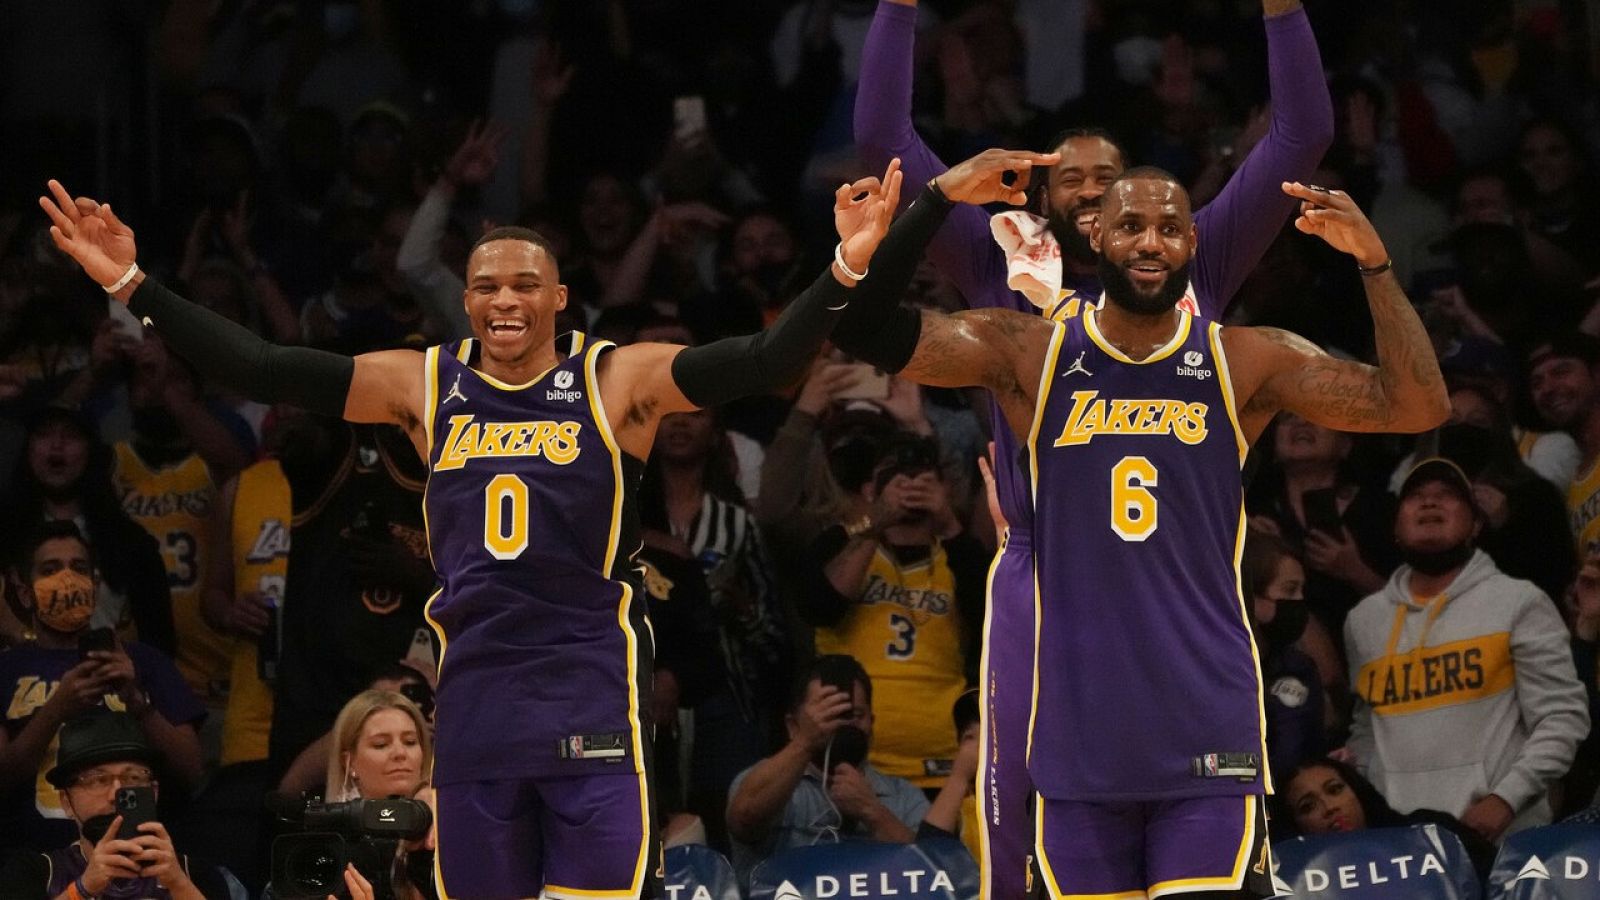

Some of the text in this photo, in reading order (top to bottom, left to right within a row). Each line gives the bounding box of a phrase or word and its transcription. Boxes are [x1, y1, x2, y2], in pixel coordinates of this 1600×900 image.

[546, 389, 582, 403] bibigo
[1176, 366, 1212, 380] bibigo
[434, 414, 582, 472] LAKERS
[1053, 390, 1209, 447] LAKERS
[484, 473, 529, 560] 0
[1110, 455, 1158, 542] 6
[166, 531, 198, 588] 3
[887, 613, 917, 658] 3
[815, 869, 956, 898] DELTA
[1304, 853, 1446, 892] DELTA
